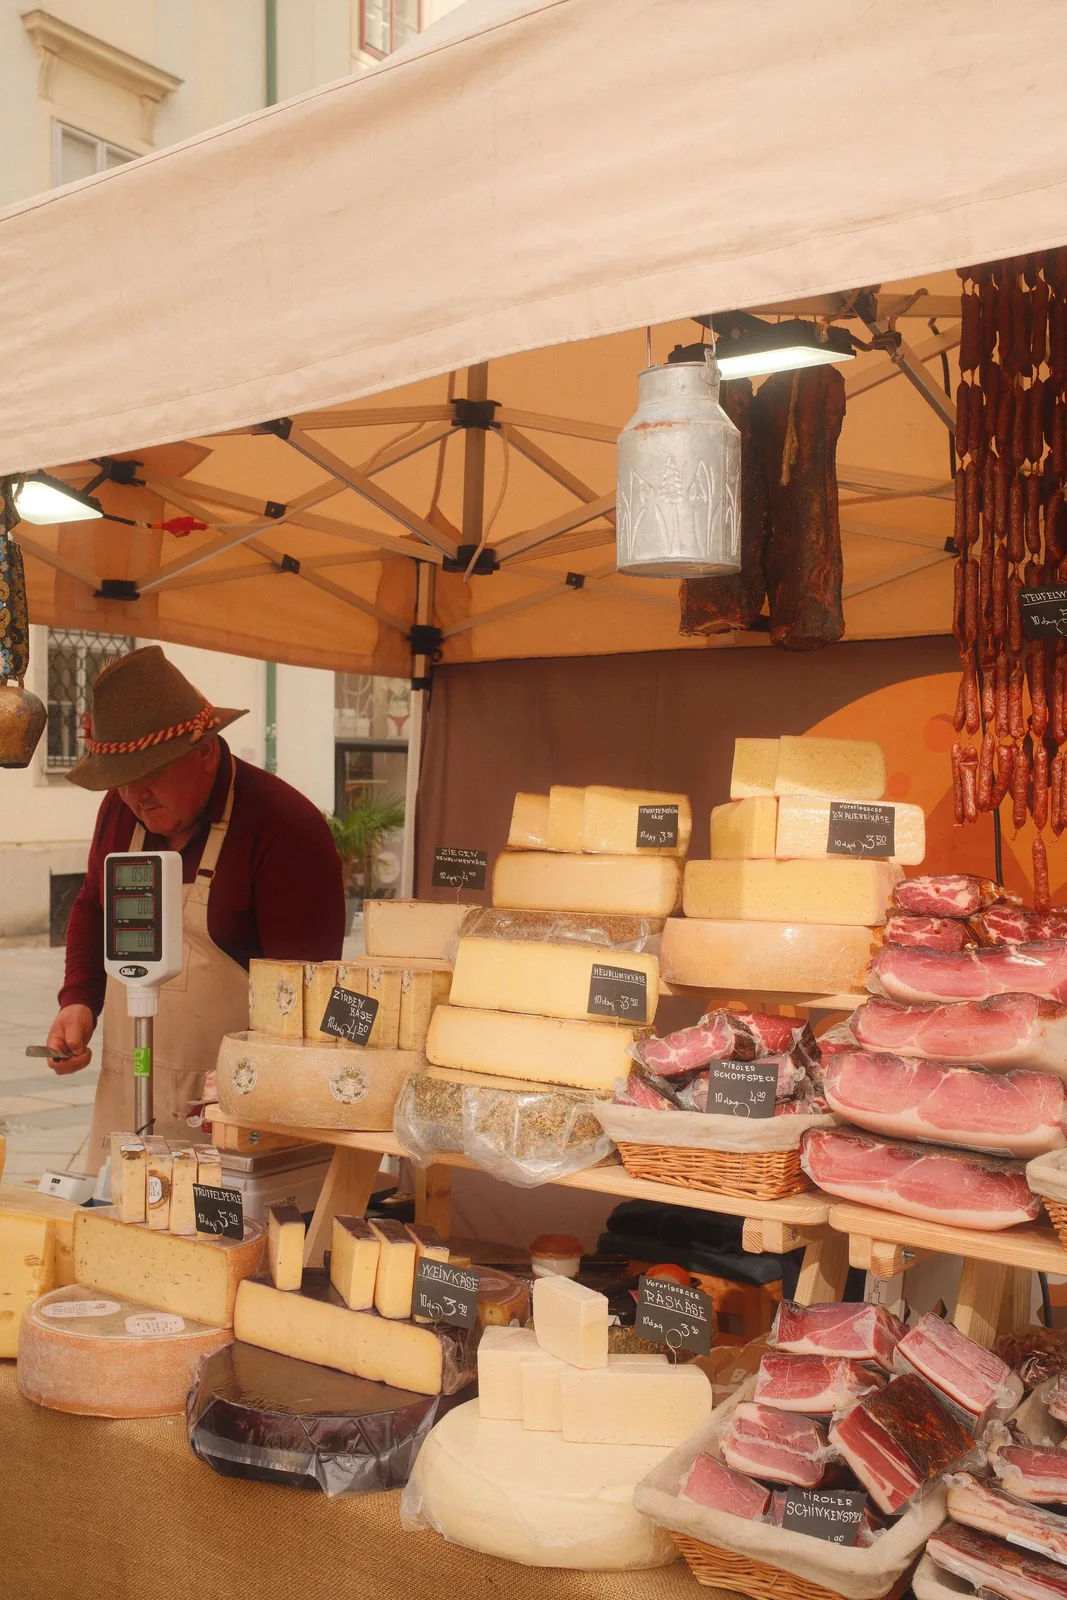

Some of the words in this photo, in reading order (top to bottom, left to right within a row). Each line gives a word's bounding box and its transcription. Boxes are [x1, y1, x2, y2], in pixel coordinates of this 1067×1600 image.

[721, 1062, 756, 1072] TIROLER
[713, 1069, 776, 1083] SCHOPFSPECK
[422, 1263, 480, 1291] WEINKÄSE
[643, 1289, 705, 1319] RÄSKÄSE
[801, 1491, 853, 1507] TIROLER
